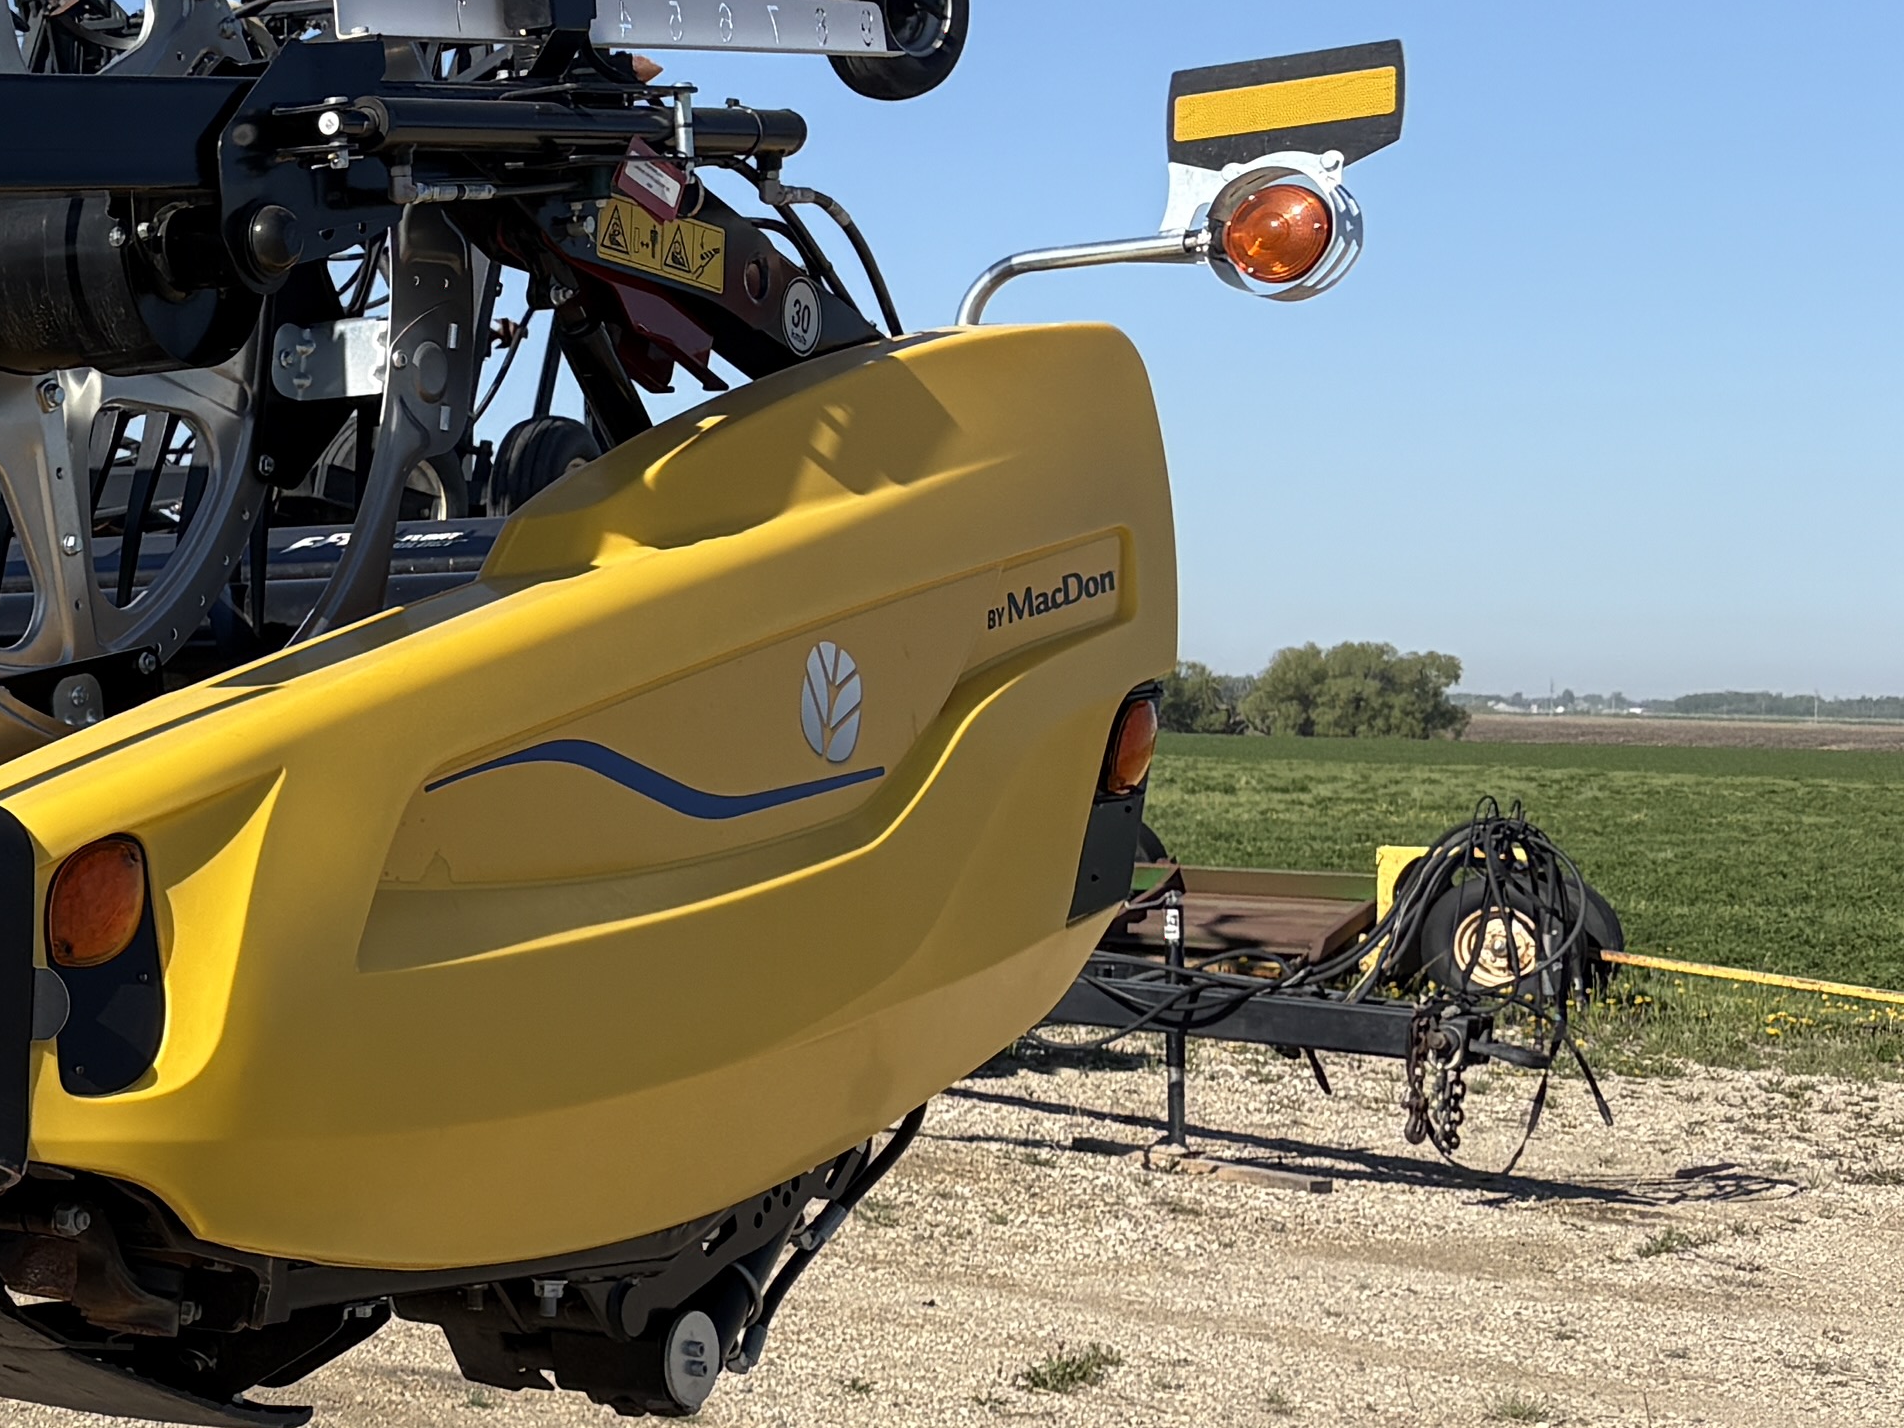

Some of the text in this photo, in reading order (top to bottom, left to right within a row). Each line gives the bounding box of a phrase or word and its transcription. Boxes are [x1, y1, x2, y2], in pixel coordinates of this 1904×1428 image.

[791, 298, 811, 334] 30
[987, 570, 1116, 630] BY MacDon
